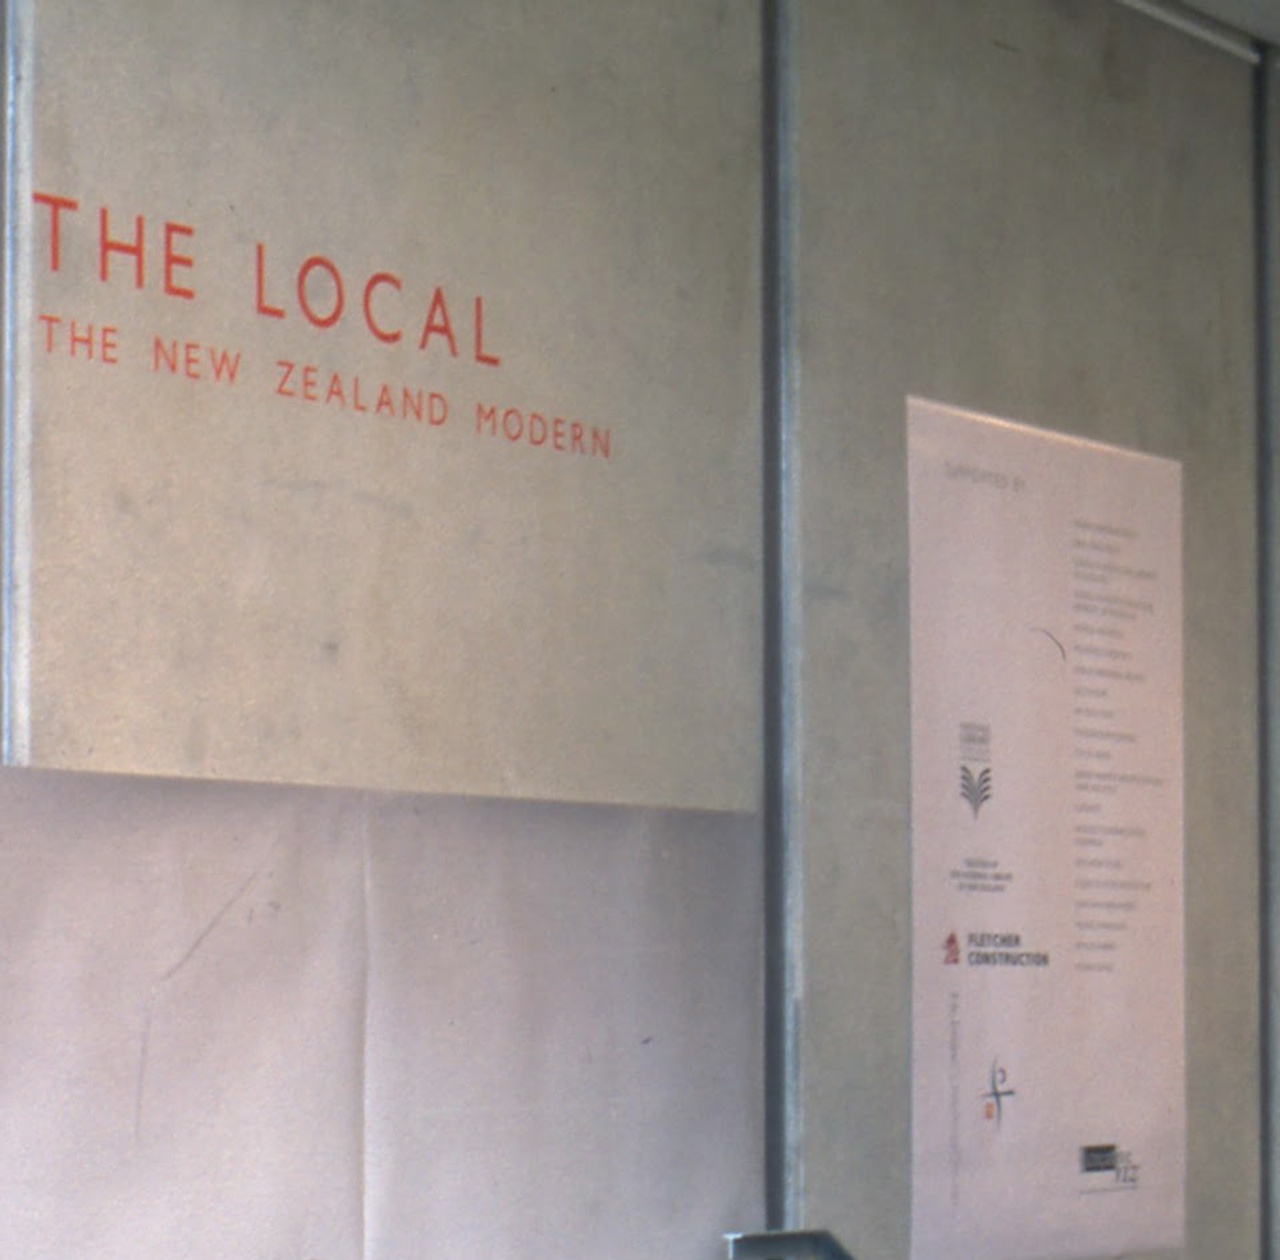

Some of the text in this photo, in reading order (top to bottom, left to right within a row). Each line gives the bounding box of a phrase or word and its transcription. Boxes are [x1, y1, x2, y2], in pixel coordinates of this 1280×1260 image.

[32, 191, 198, 302] THE
[254, 243, 502, 368] LOCAL
[37, 313, 120, 366] THE
[152, 335, 242, 386] NEW
[275, 359, 451, 428] ZEALAND
[475, 402, 613, 461] MODERN
[966, 932, 1022, 948] FLETCHER
[966, 951, 1050, 967] CONSTRUCTION
